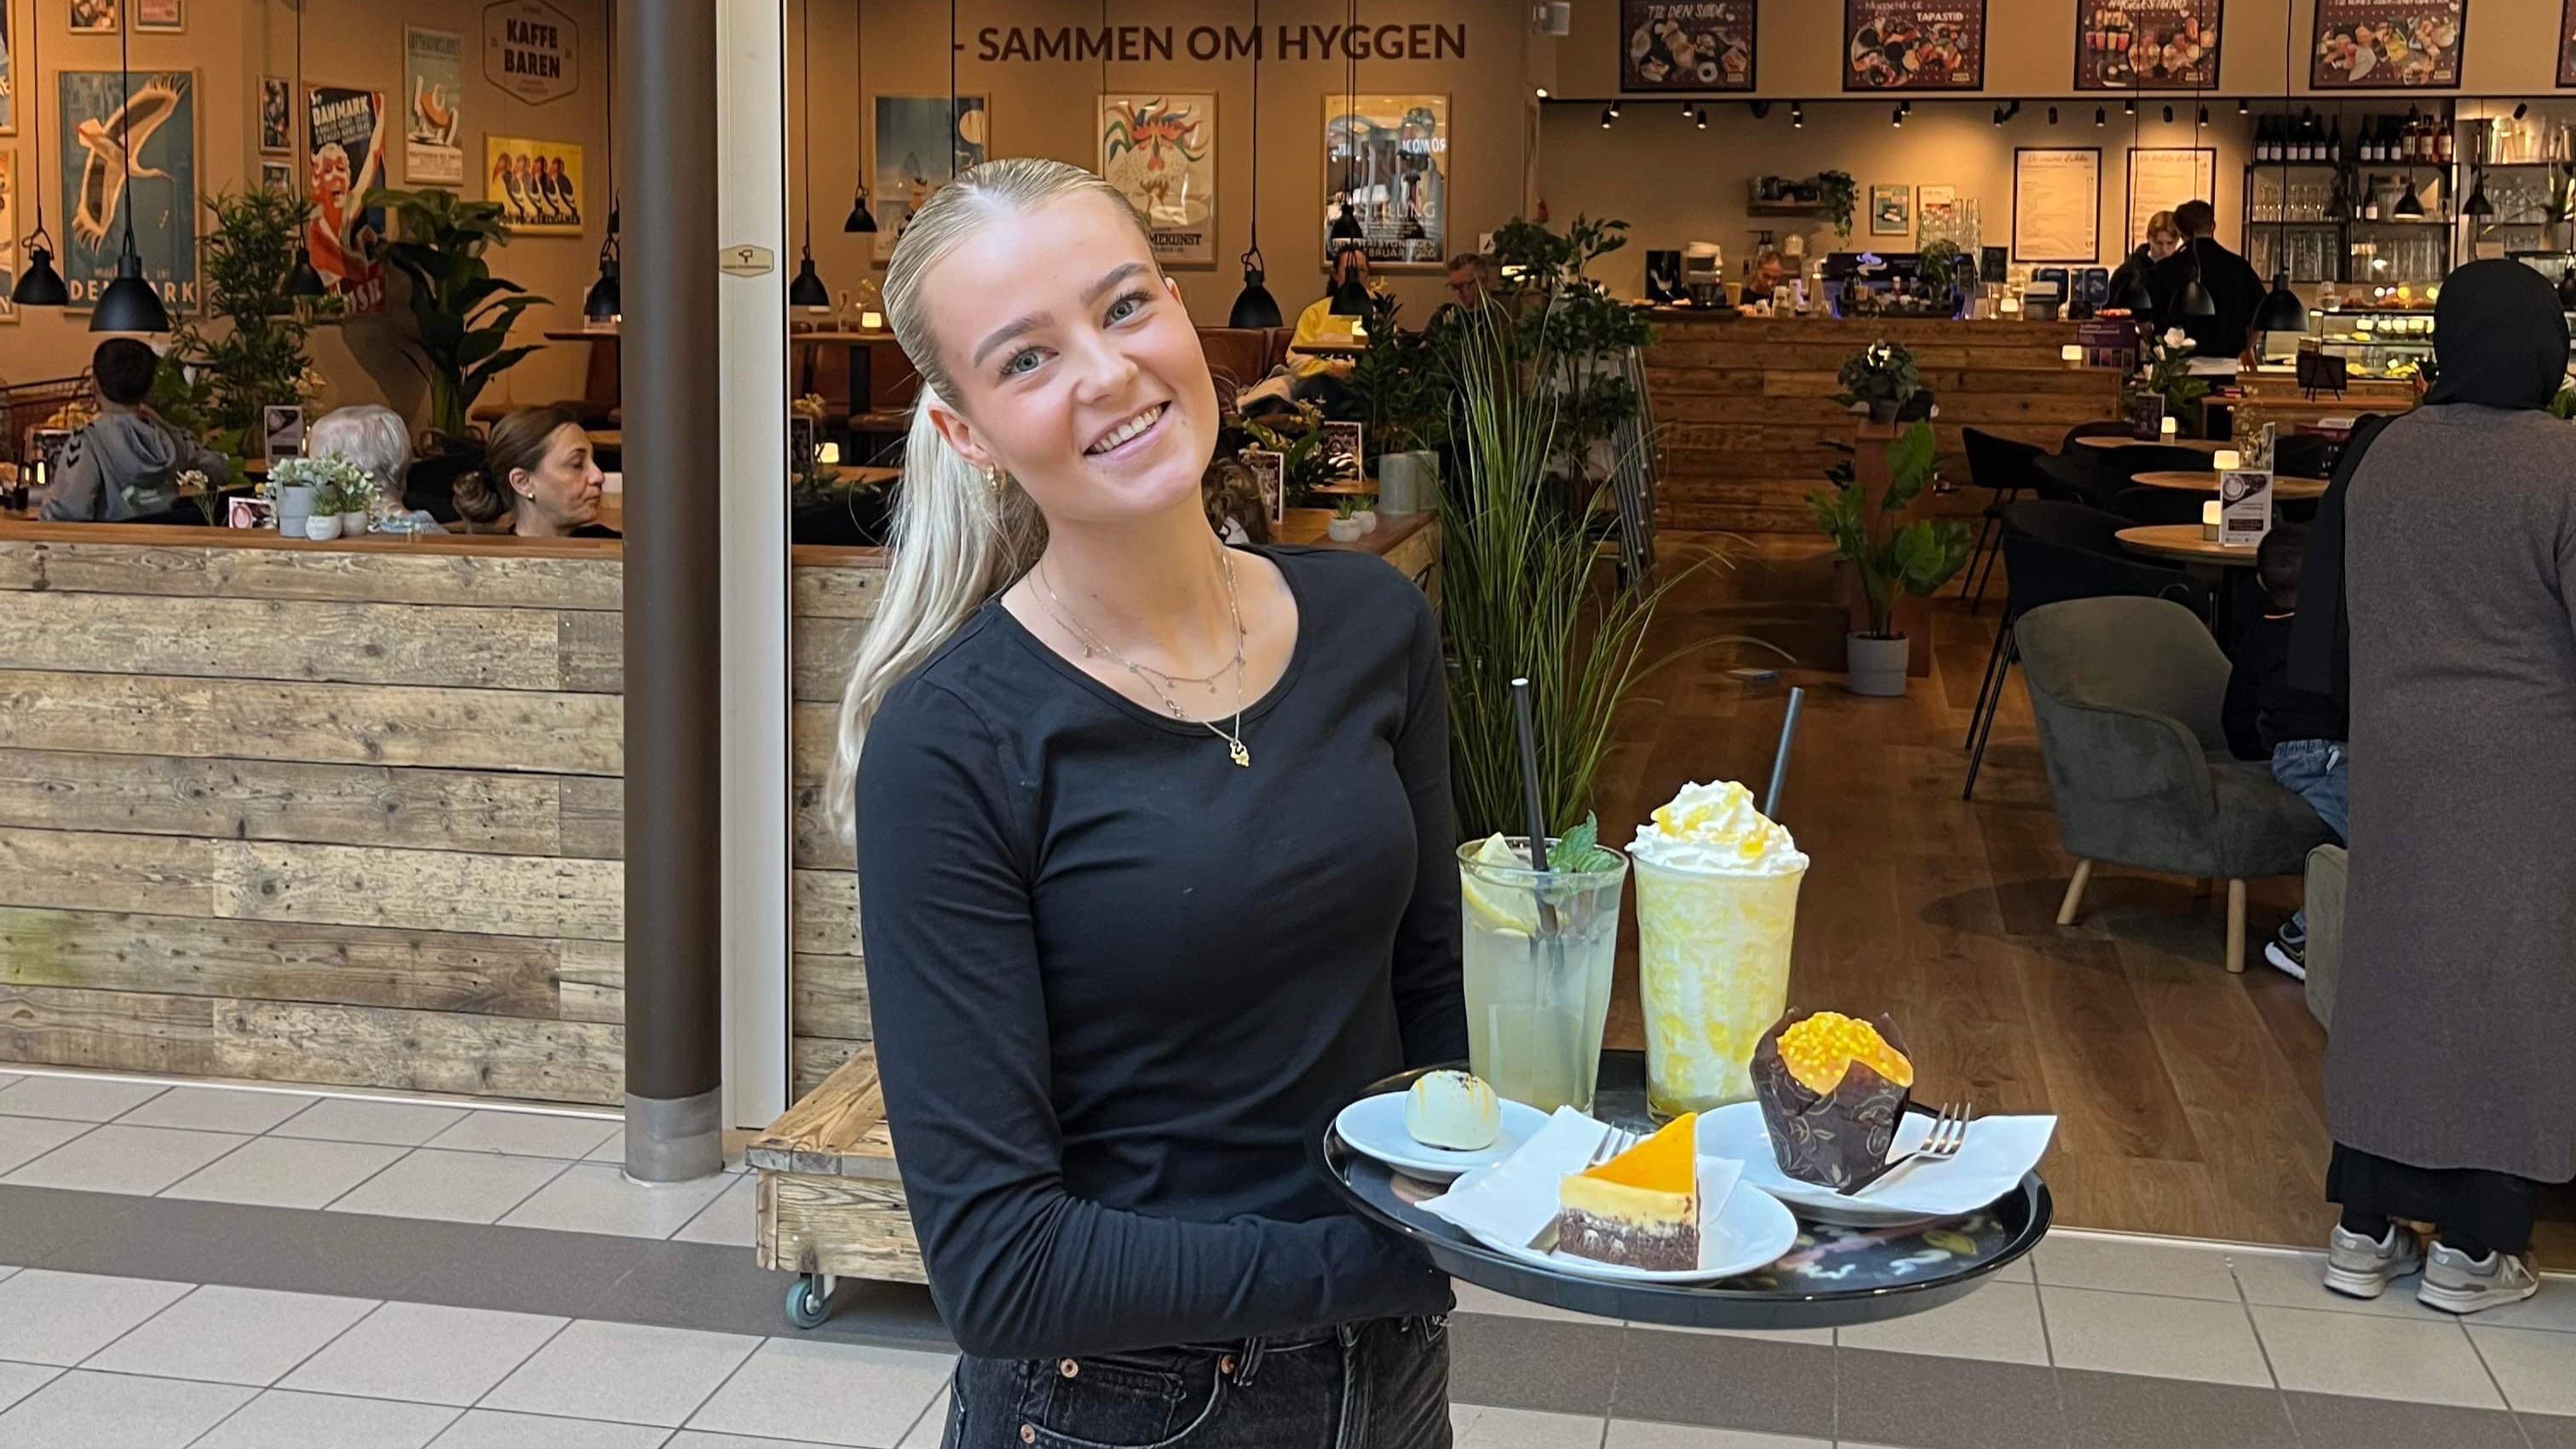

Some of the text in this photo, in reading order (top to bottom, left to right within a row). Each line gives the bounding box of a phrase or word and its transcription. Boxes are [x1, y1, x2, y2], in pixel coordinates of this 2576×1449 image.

[506, 18, 558, 49] KAFFE
[978, 26, 1173, 61] SAMMEN
[1186, 26, 1262, 60] OM
[1278, 24, 1466, 60] HYGGEN
[504, 49, 560, 79] BAREN
[312, 95, 370, 127] DANMARK
